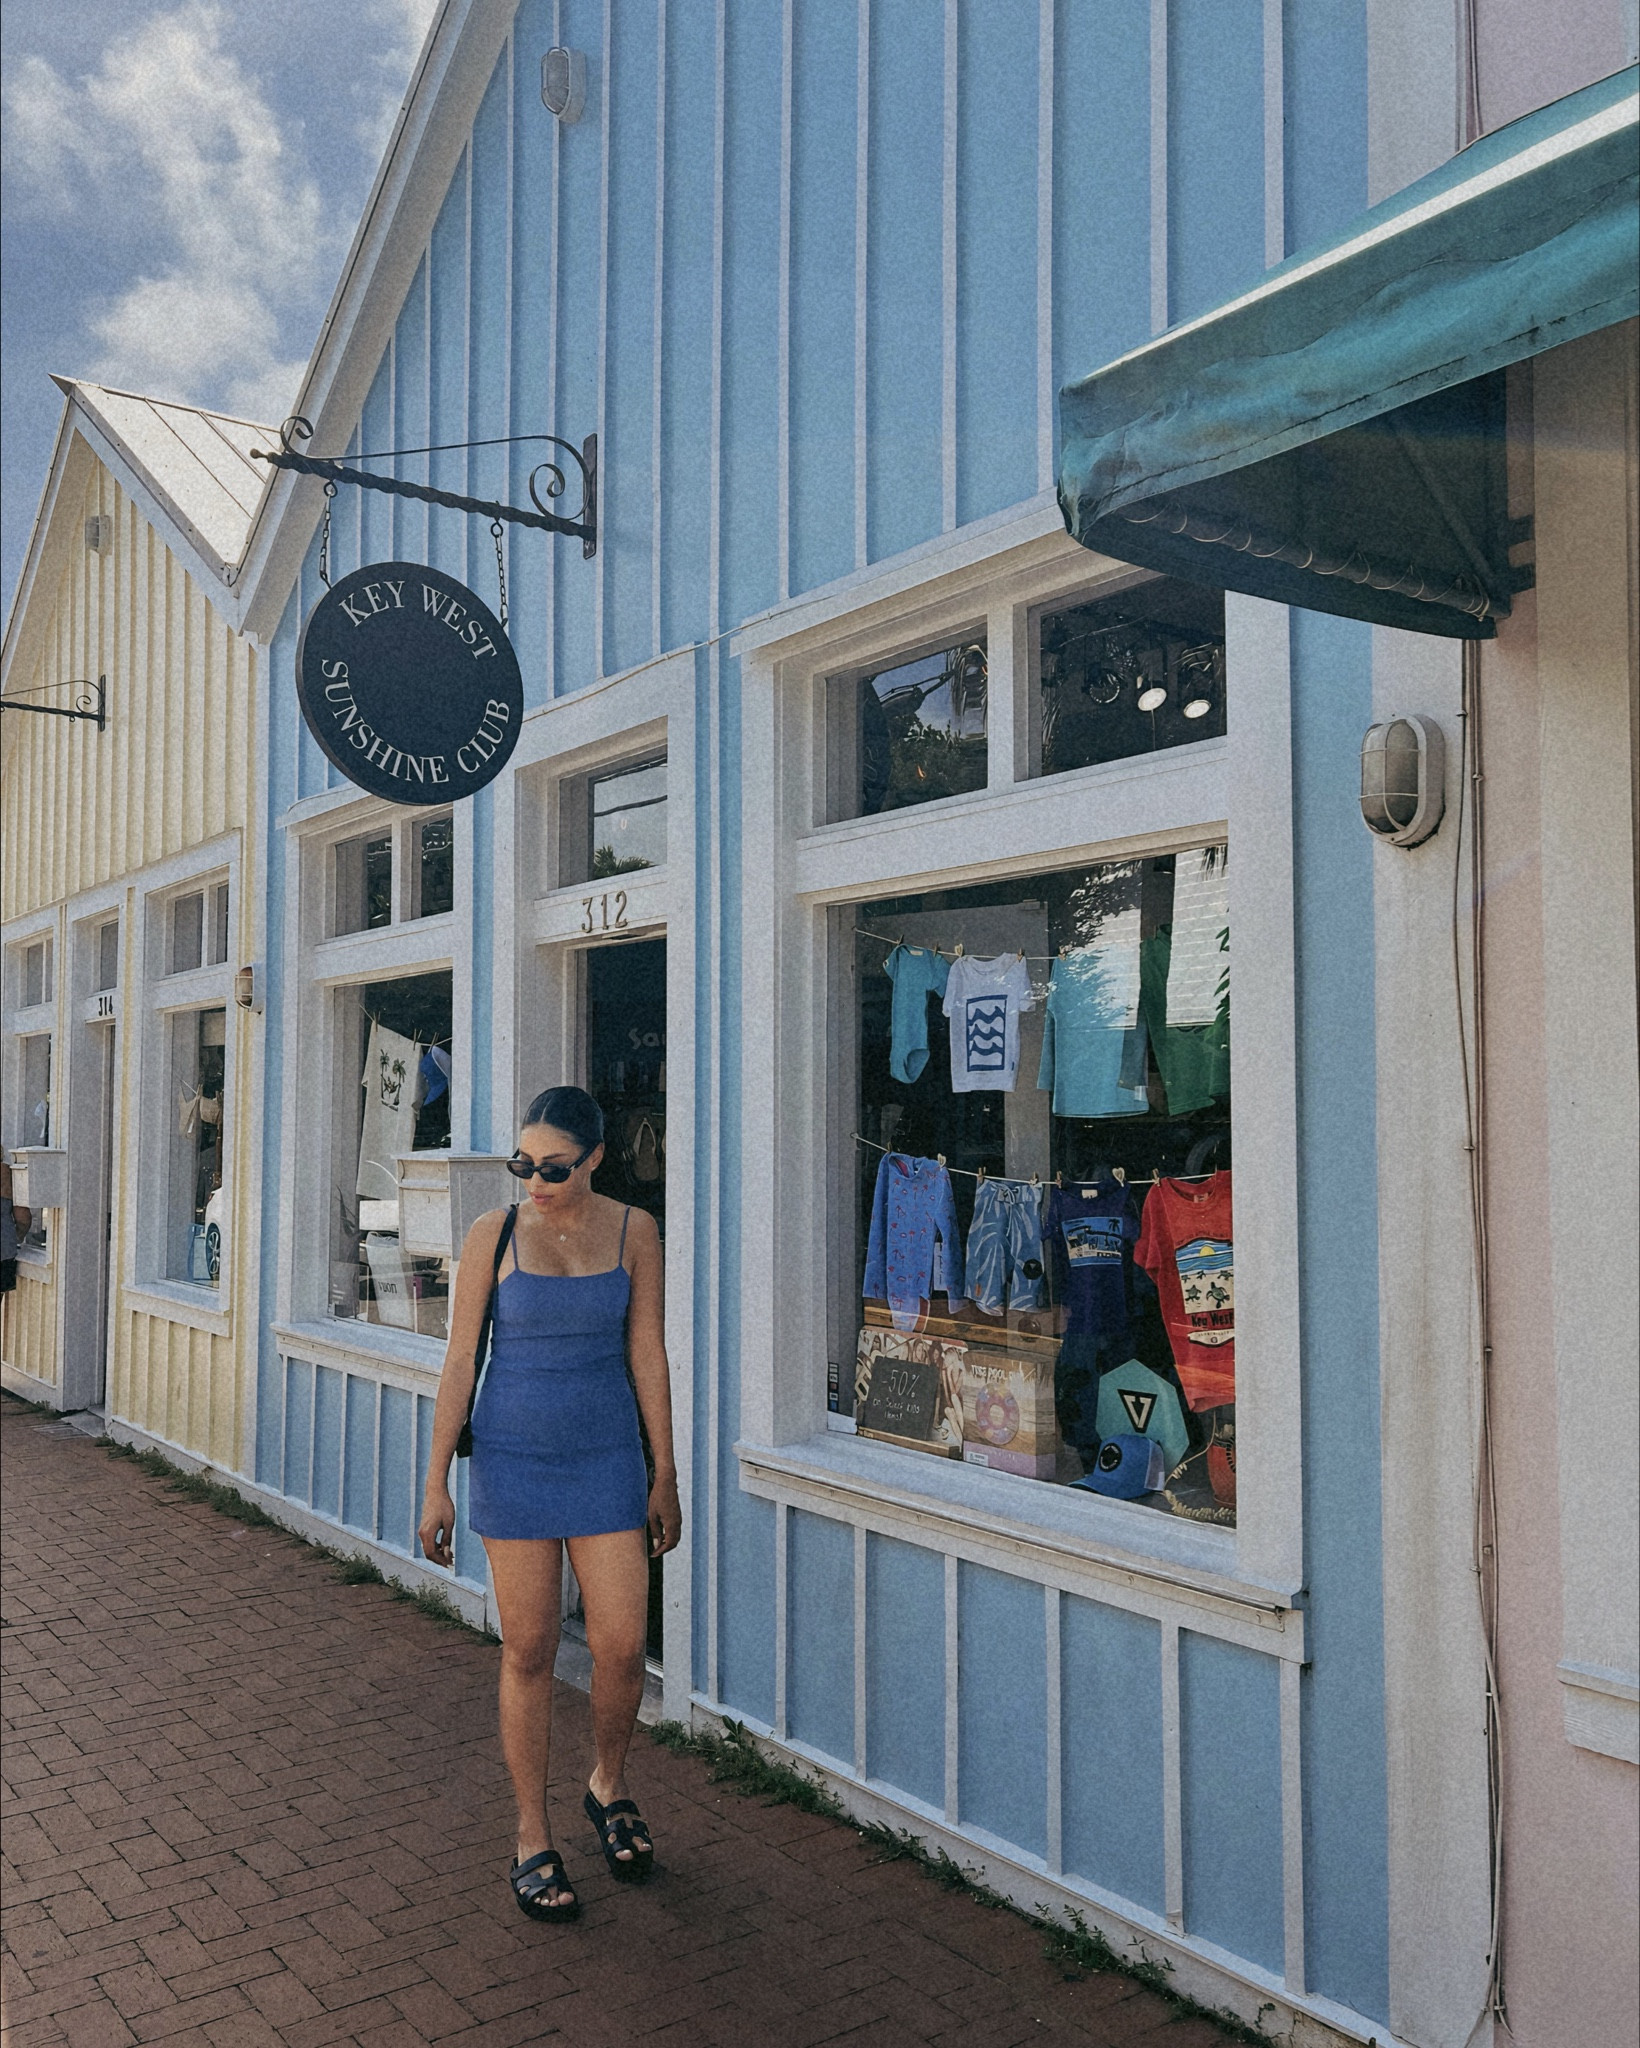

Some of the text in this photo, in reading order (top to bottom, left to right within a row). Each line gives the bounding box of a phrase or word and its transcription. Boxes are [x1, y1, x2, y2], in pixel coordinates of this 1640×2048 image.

[338, 580, 497, 660] KEY WEST
[321, 659, 510, 784] SUNSHINE CLUB
[581, 890, 628, 933] 312
[98, 995, 113, 1017] 314
[628, 1027, 665, 1050] Sa
[881, 1369, 920, 1398] -50%
